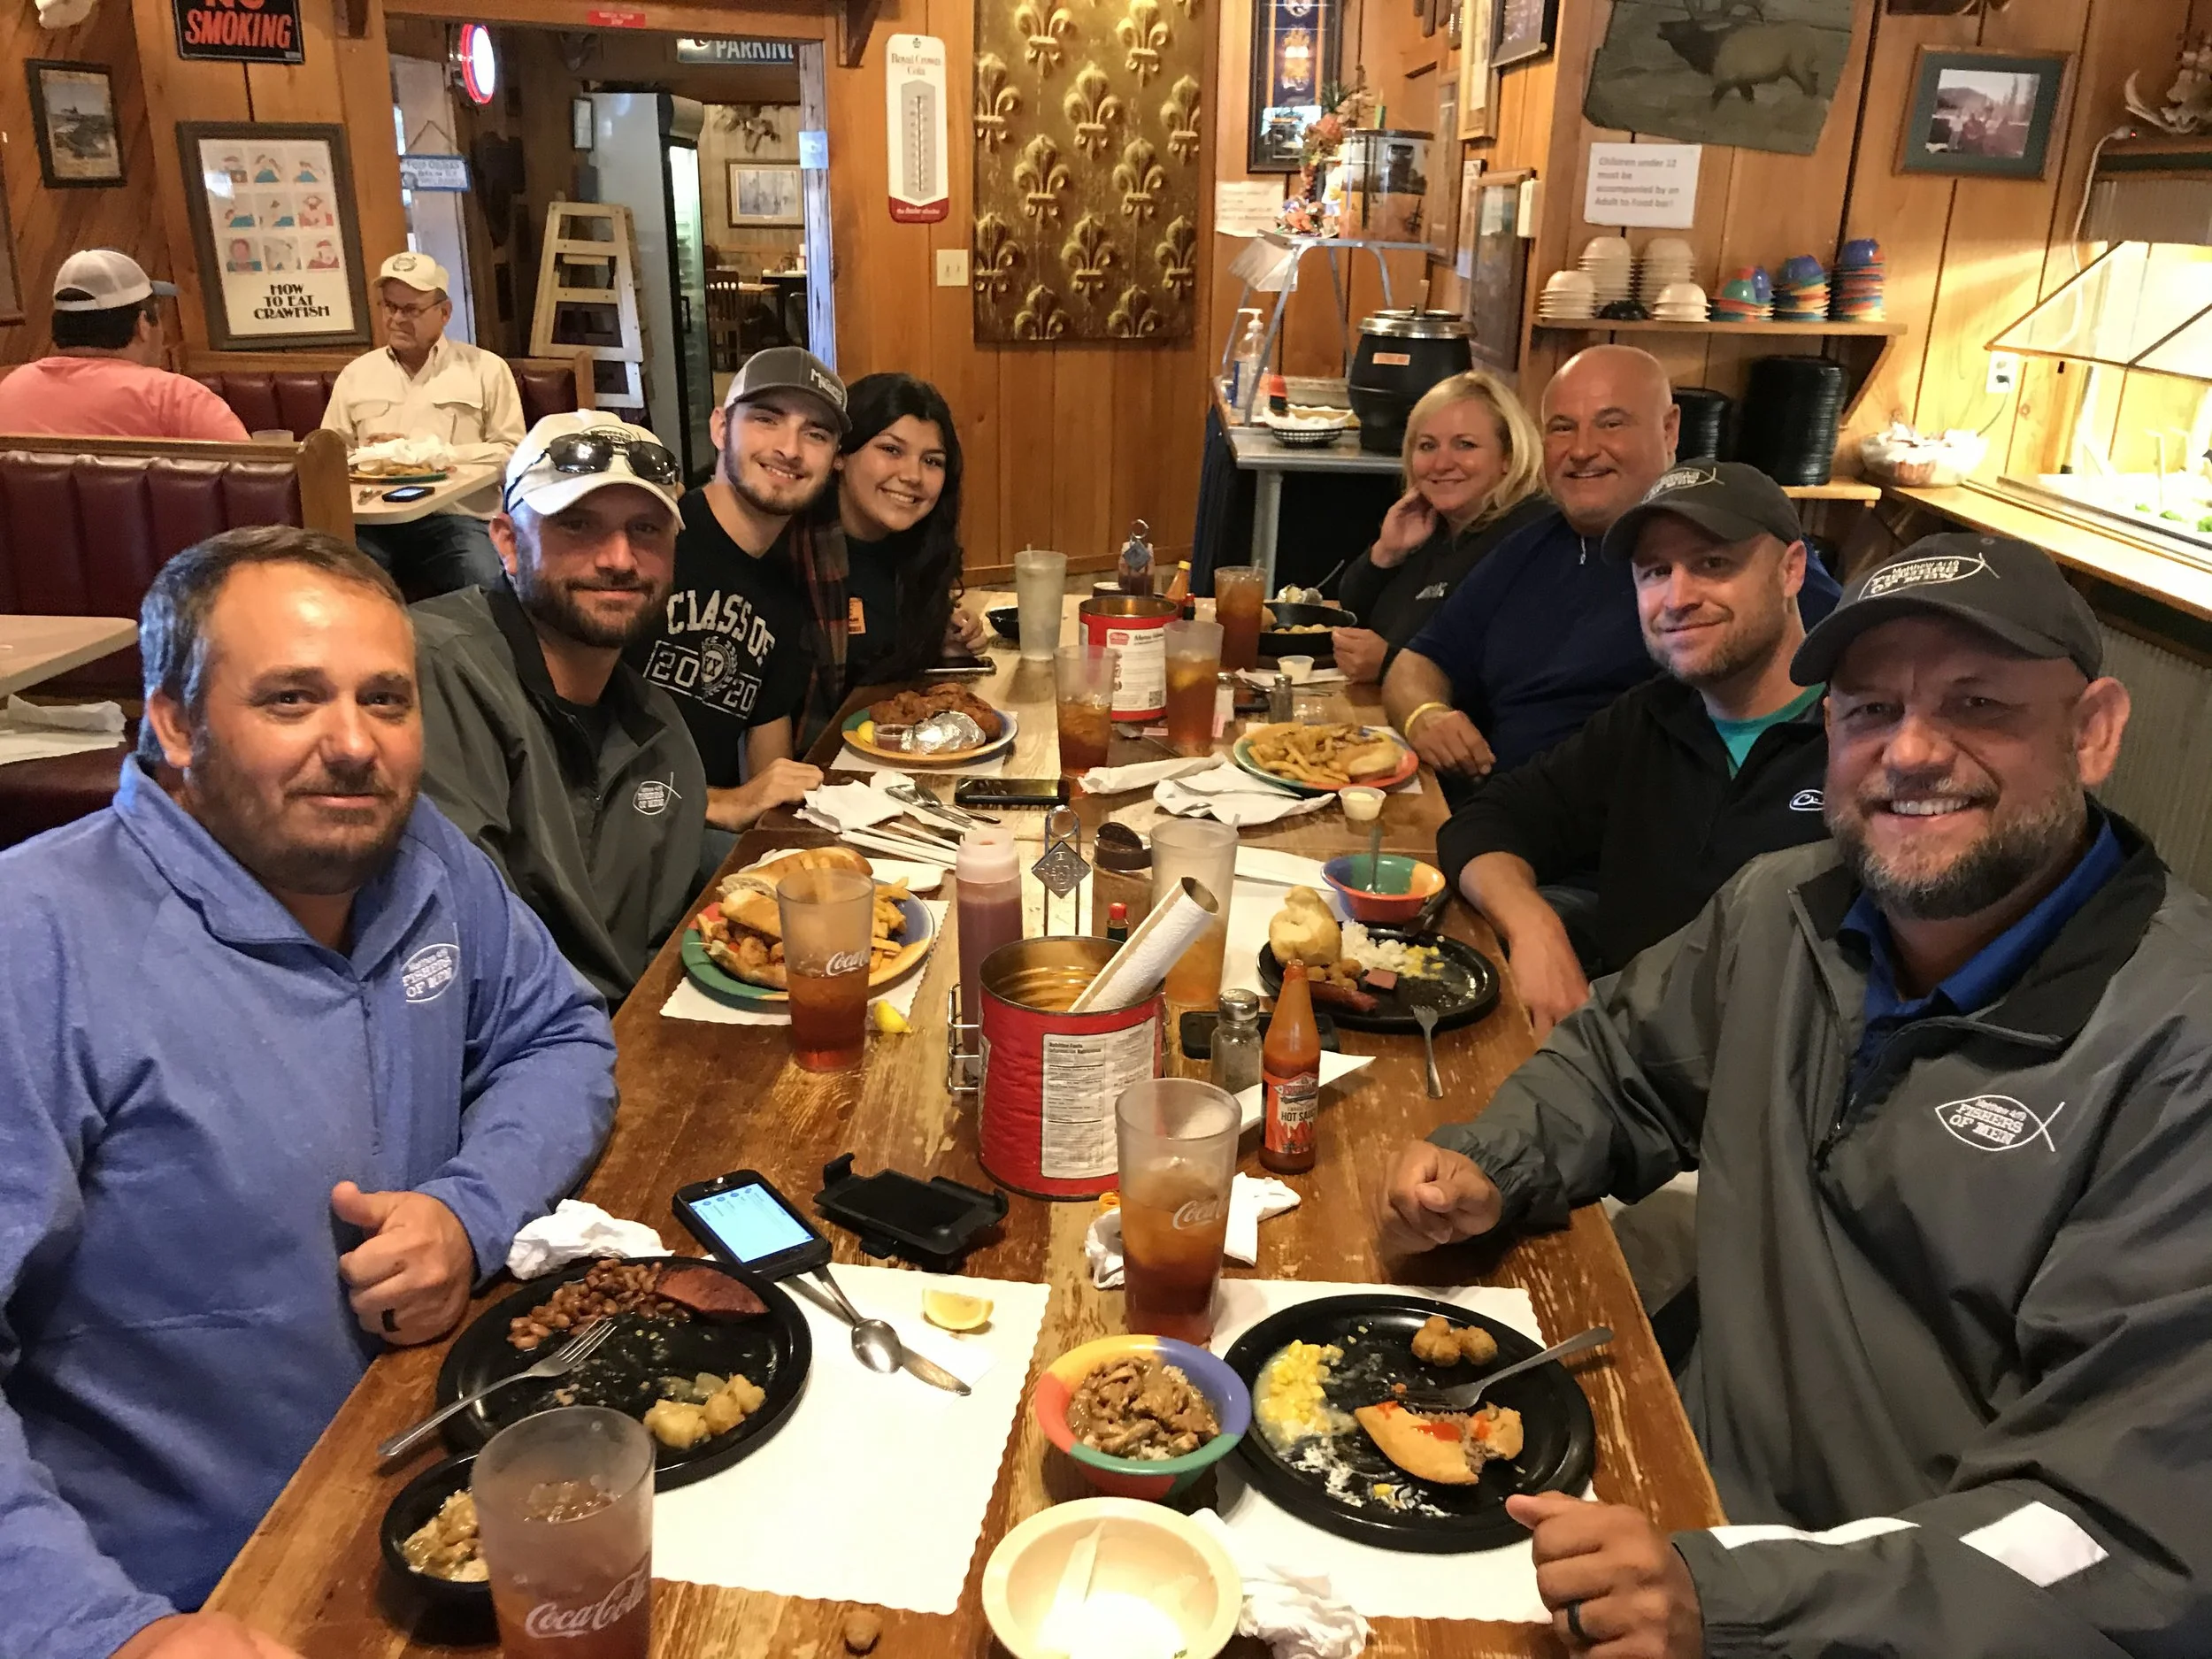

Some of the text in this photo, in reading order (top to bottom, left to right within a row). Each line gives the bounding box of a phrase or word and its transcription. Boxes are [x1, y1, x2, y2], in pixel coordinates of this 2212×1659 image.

[185, 9, 293, 49] SMOKING
[263, 295, 314, 308] TO EAT
[270, 284, 304, 296] HOW
[253, 306, 331, 319] CRAWFISH
[666, 589, 776, 668] CLASS OF
[650, 649, 757, 713] 20 20
[1281, 1110, 1296, 1122] HOT
[1949, 1114, 2016, 1145] OF MEN
[1955, 1103, 2024, 1133] FISHERS
